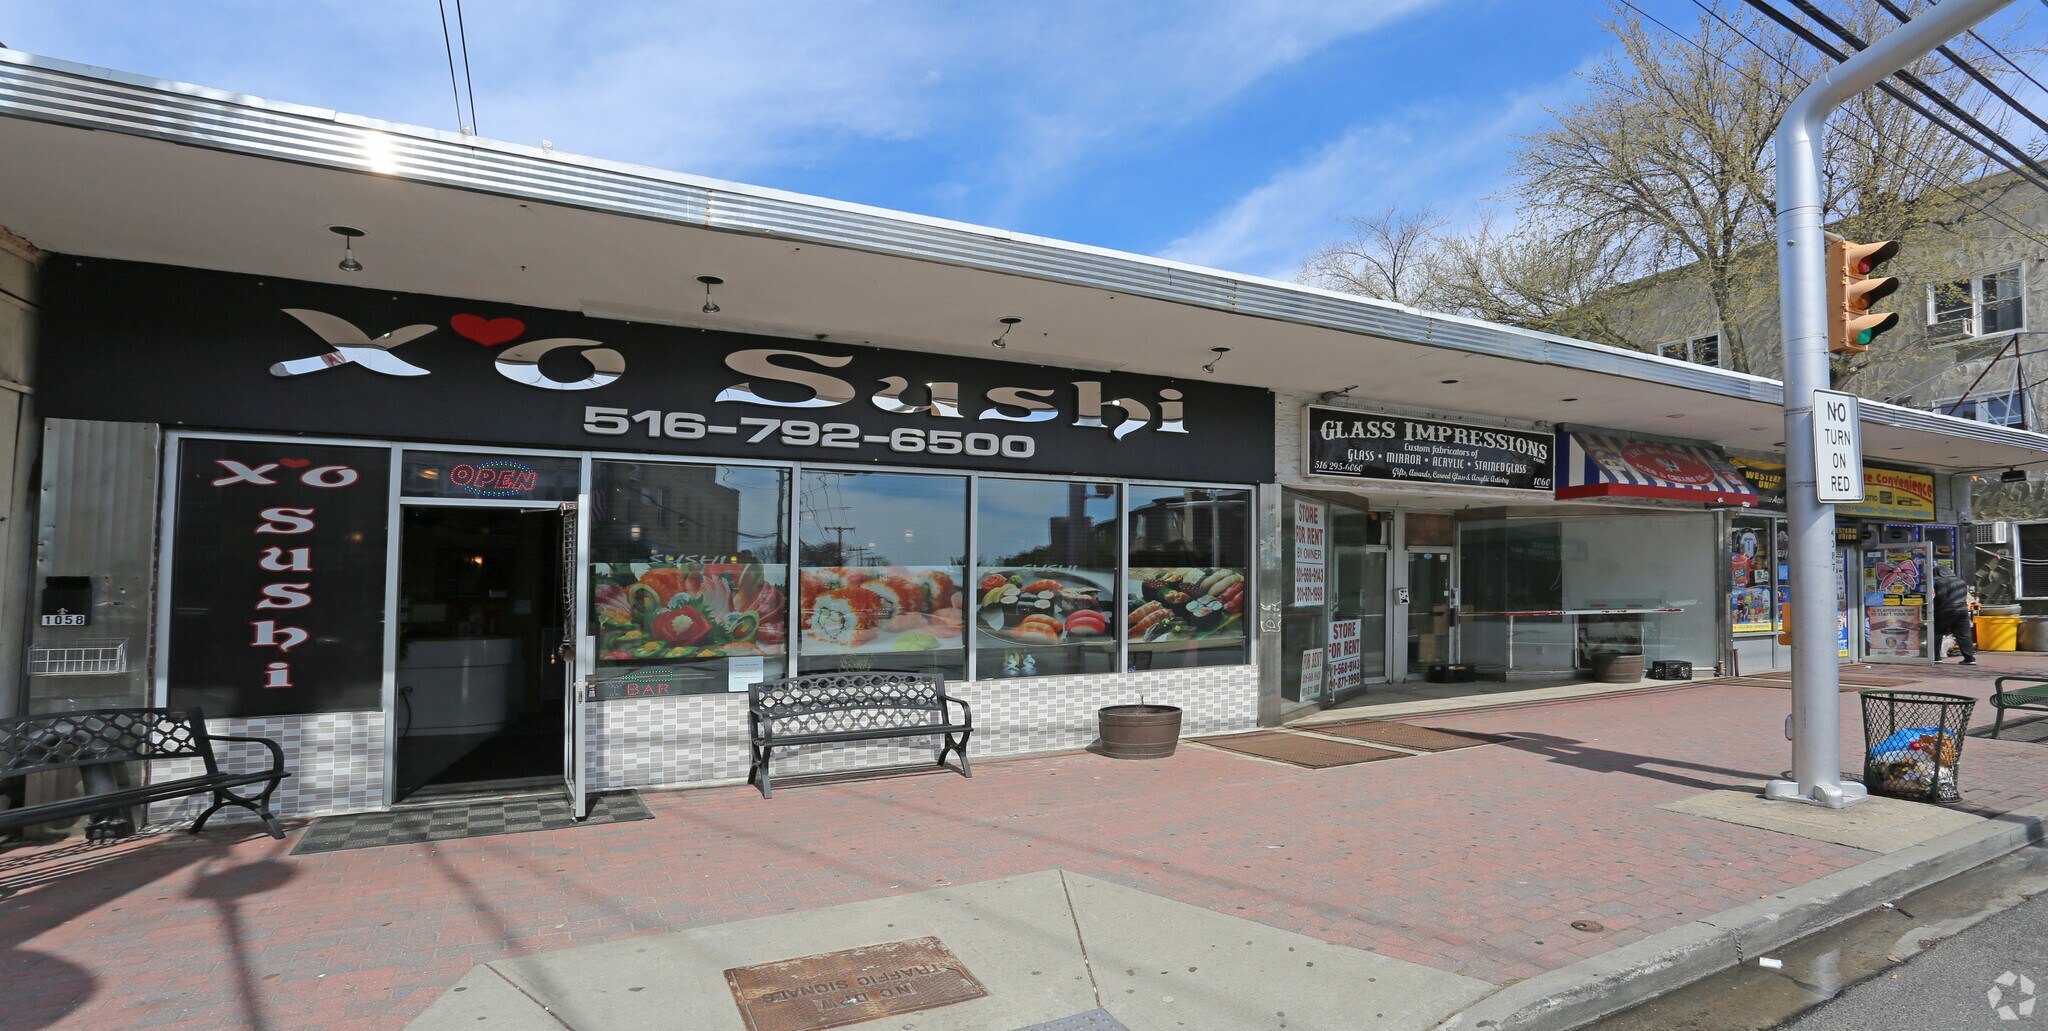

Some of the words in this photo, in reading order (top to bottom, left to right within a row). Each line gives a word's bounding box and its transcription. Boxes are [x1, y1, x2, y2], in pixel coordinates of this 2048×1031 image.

[714, 347, 1190, 442] Sushi
[1827, 401, 1846, 422] NO
[583, 405, 1036, 459] 516-792-6500
[1320, 420, 1396, 441] GLASS
[1404, 422, 1548, 460] IMPRESSIONS
[1825, 429, 1850, 446] TURN
[1348, 449, 1375, 462] GLASS
[1386, 452, 1422, 465] MIRROR
[1432, 456, 1464, 469] ACRYLIC
[1404, 443, 1430, 453] Custom
[1432, 446, 1470, 457] fabricators
[1470, 450, 1478, 459] of
[1832, 453, 1846, 468] ON
[1314, 460, 1328, 470] 516
[1328, 462, 1363, 472] 295-6060
[1392, 467, 1408, 478] Gifts,
[1409, 469, 1432, 478] Awards,
[1432, 471, 1451, 480] Carved
[1452, 472, 1466, 482] Glass
[1472, 474, 1489, 483] Acrylic
[450, 463, 538, 491] OPEN
[1534, 478, 1550, 486] 1060
[1831, 476, 1850, 492] RED
[1864, 473, 1872, 483] re
[1876, 473, 1932, 498] Convenience
[1298, 504, 1318, 524] STORE
[1296, 525, 1306, 544] FOR
[1307, 528, 1324, 546] RENT
[1296, 548, 1303, 558] BY
[1303, 548, 1322, 560] OWNER
[45, 616, 84, 624] 1058
[1332, 621, 1356, 640] STORE
[1344, 638, 1360, 656] RENT
[626, 683, 670, 696] BAR
[858, 964, 941, 986] TRAFFIC
[762, 980, 849, 1004] SIGNALS
